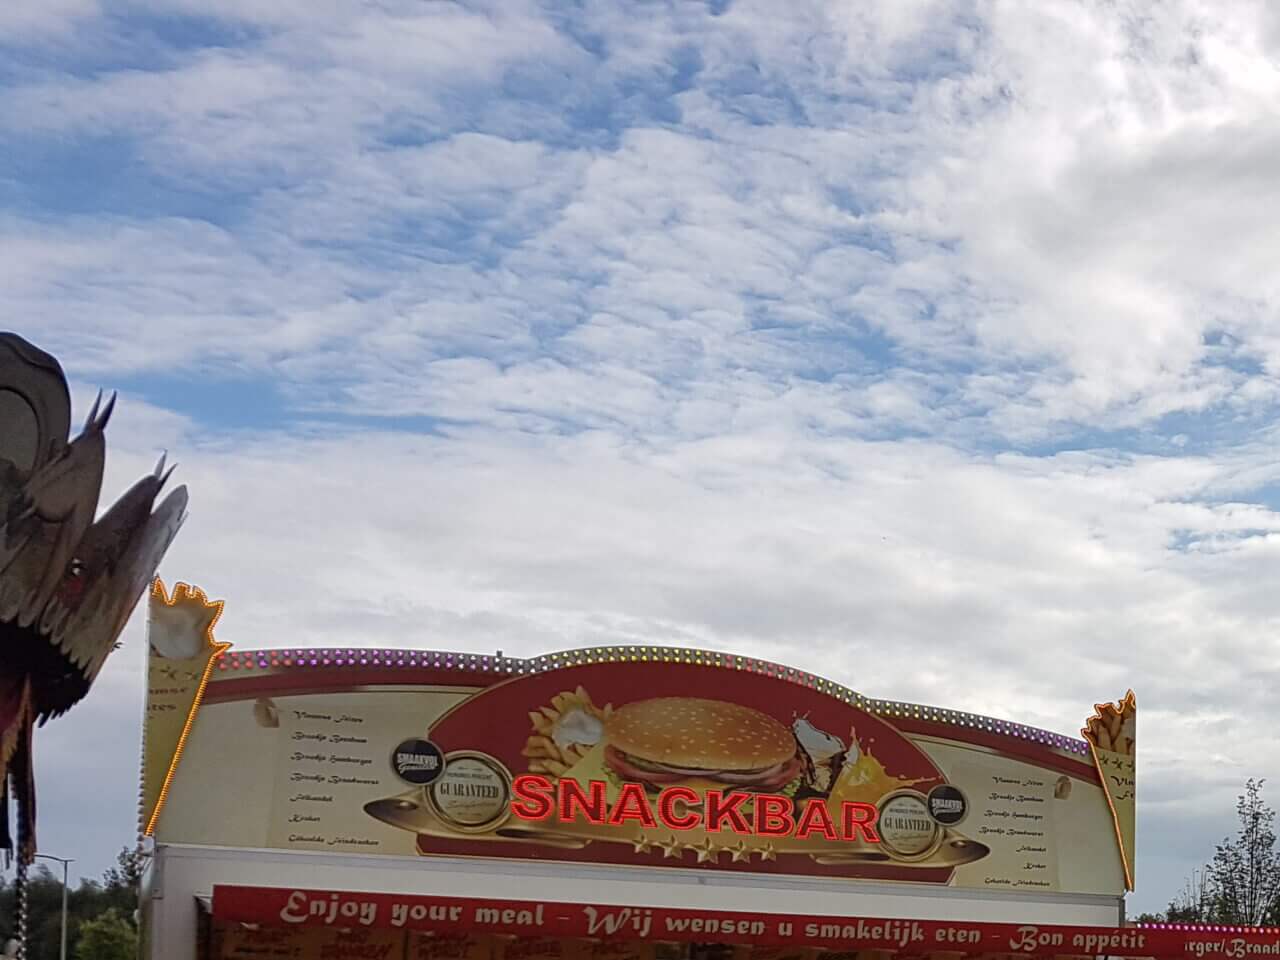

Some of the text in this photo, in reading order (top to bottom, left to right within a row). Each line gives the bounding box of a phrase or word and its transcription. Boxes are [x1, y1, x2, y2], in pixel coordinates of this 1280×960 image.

[440, 782, 499, 799] GUARANTEED
[511, 774, 881, 844] SNACKBAR
[884, 817, 931, 832] GUARANTEED
[279, 890, 378, 927] Enjoy
[390, 902, 464, 928] your
[474, 903, 545, 926] meal
[582, 905, 653, 938] Wij
[664, 916, 767, 936] wensen
[777, 921, 794, 937] u
[804, 918, 925, 949] smakelijk
[934, 925, 982, 944] eten
[1008, 925, 1065, 952] Bon
[1072, 929, 1147, 954] appétit
